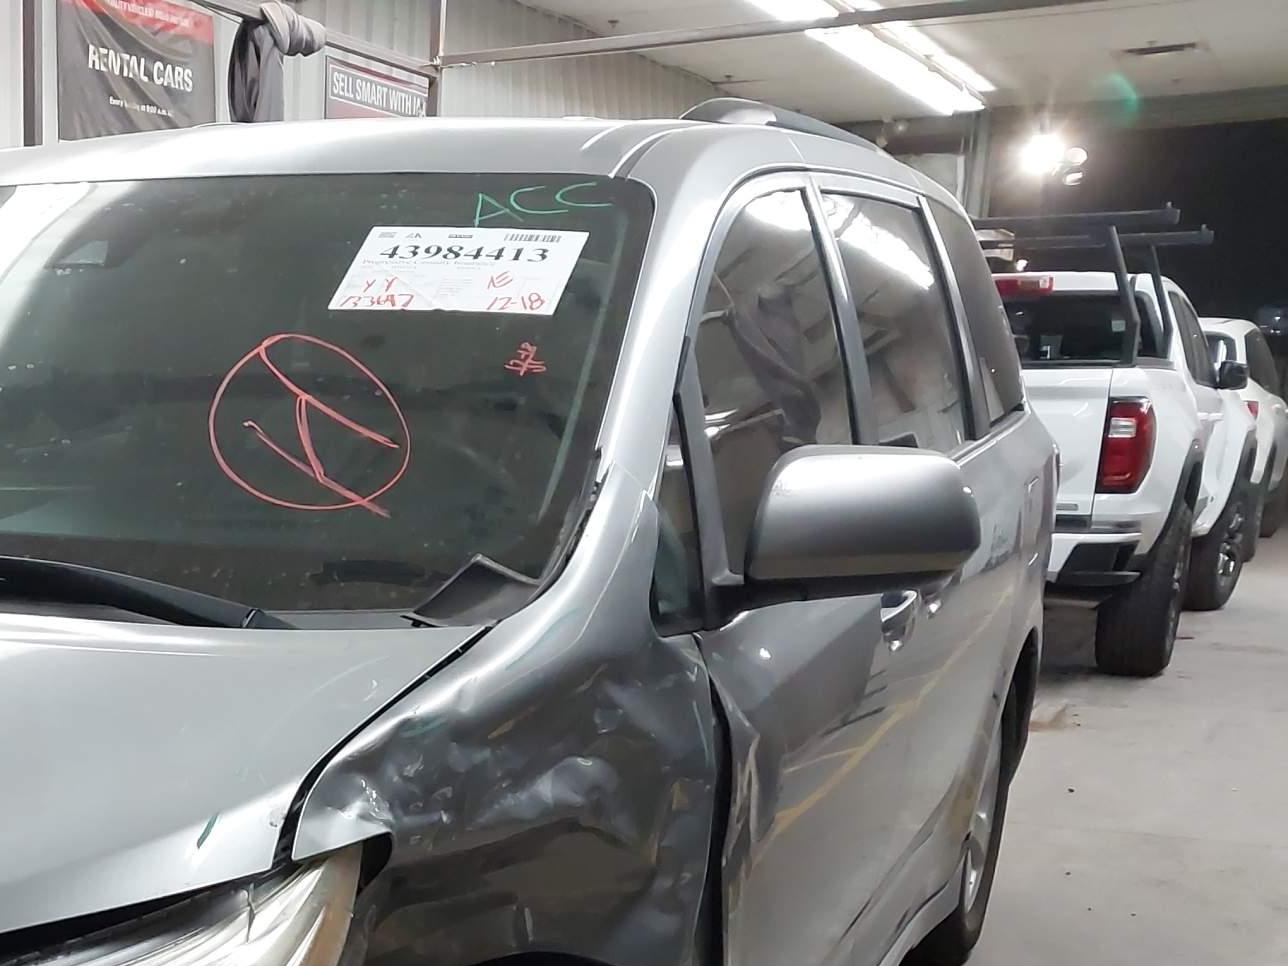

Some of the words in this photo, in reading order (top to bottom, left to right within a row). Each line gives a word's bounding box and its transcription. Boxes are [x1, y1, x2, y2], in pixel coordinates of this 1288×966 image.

[88, 43, 149, 83] RENTAL
[153, 61, 193, 92] CARS
[333, 71, 354, 98] SELL
[355, 78, 388, 108] SMART
[389, 88, 412, 115] WITH
[473, 182, 612, 228] ACC
[379, 244, 549, 262] 43984413
